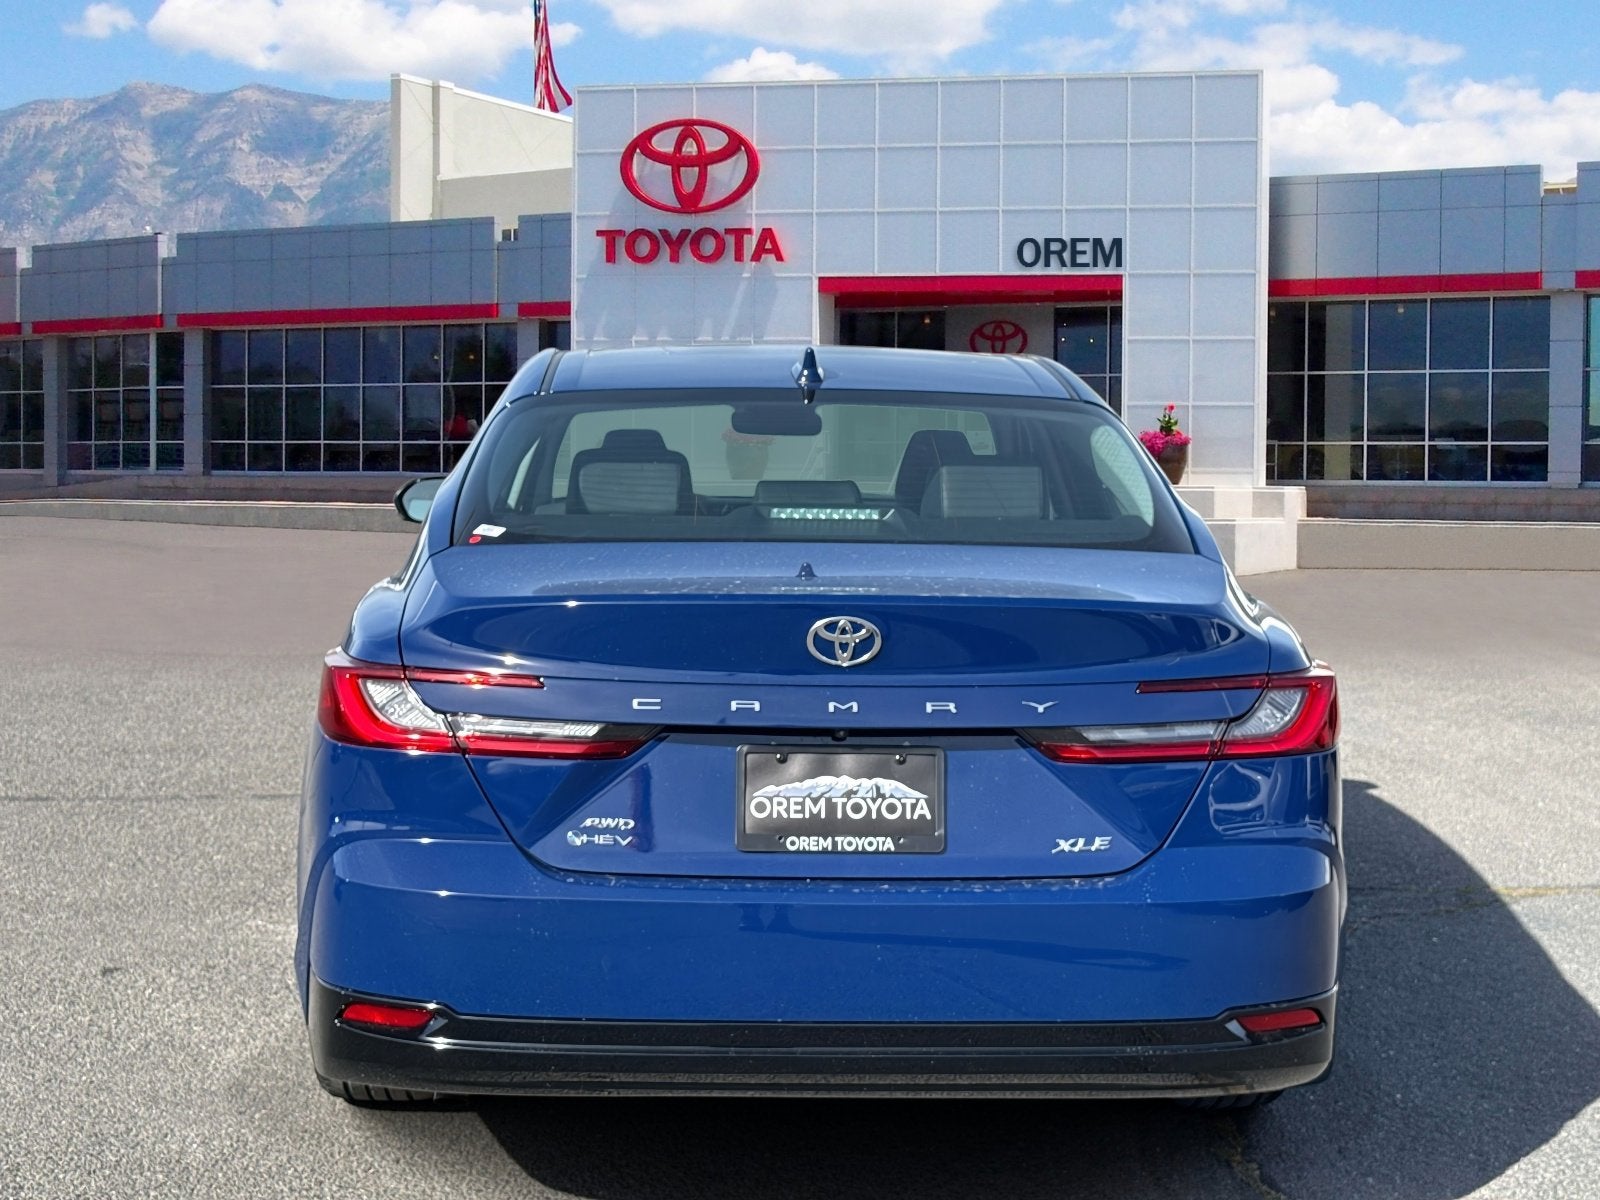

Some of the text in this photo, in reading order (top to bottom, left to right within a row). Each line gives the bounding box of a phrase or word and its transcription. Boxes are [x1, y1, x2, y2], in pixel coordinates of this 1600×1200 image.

[596, 226, 785, 264] TOYOTA
[1016, 237, 1123, 268] OREM
[632, 698, 1059, 714] CAMRY
[749, 796, 932, 820] OREM TOYOTA
[580, 816, 635, 830] AWD
[579, 834, 633, 847] HEV
[786, 835, 895, 852] OREM TOYOTA
[1051, 836, 1112, 854] XLE
